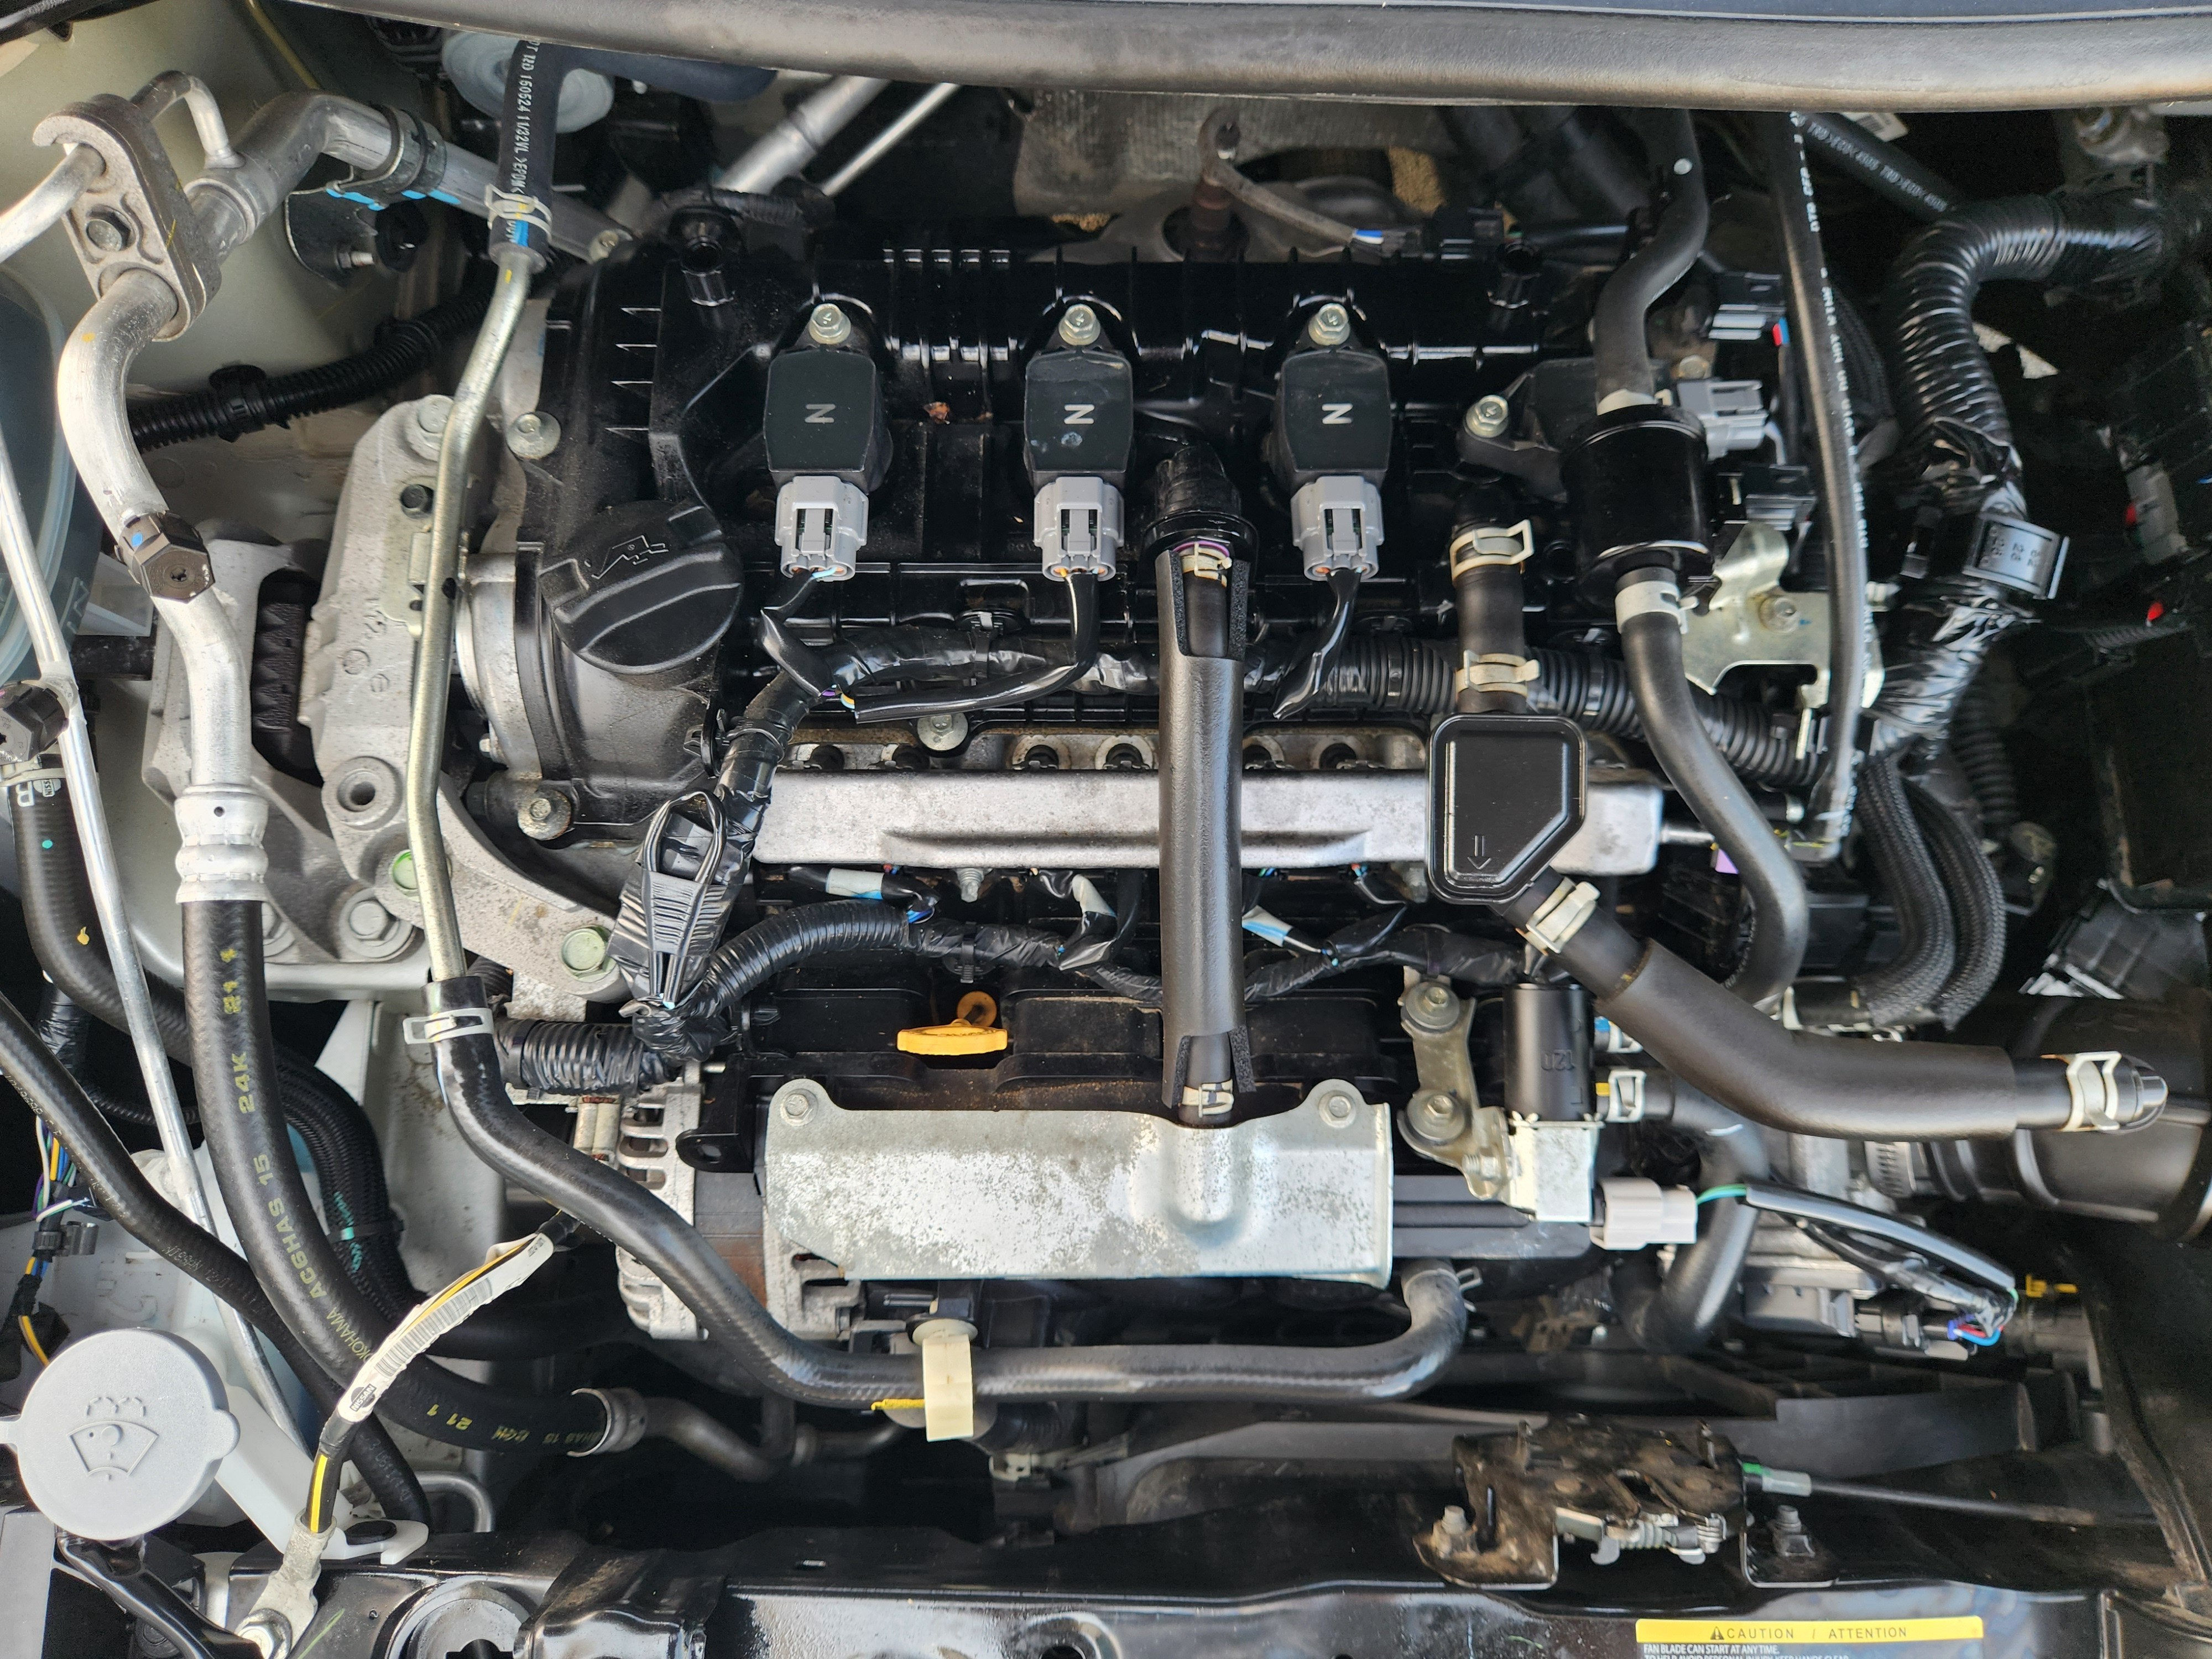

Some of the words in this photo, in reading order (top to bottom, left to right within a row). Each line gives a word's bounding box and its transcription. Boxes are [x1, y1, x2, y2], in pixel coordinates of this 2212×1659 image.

[44, 778, 53, 796] NISS
[230, 1052, 256, 1115] 24K
[253, 1153, 270, 1186] 15
[326, 1306, 375, 1362] OKOHAMA
[351, 1384, 376, 1411] NISSAN
[446, 1413, 473, 1431] 21
[1726, 1627, 1794, 1639] CAUTION
[1828, 1627, 1907, 1639] ATTENTION
[1644, 1644, 1659, 1654] FAN
[1660, 1644, 1687, 1655] BLADE
[1687, 1644, 1704, 1655] CAN
[1705, 1644, 1730, 1655] START
[1730, 1645, 1740, 1655] AT
[1742, 1645, 1758, 1655] ANY
[1760, 1645, 1780, 1655] TIME.
